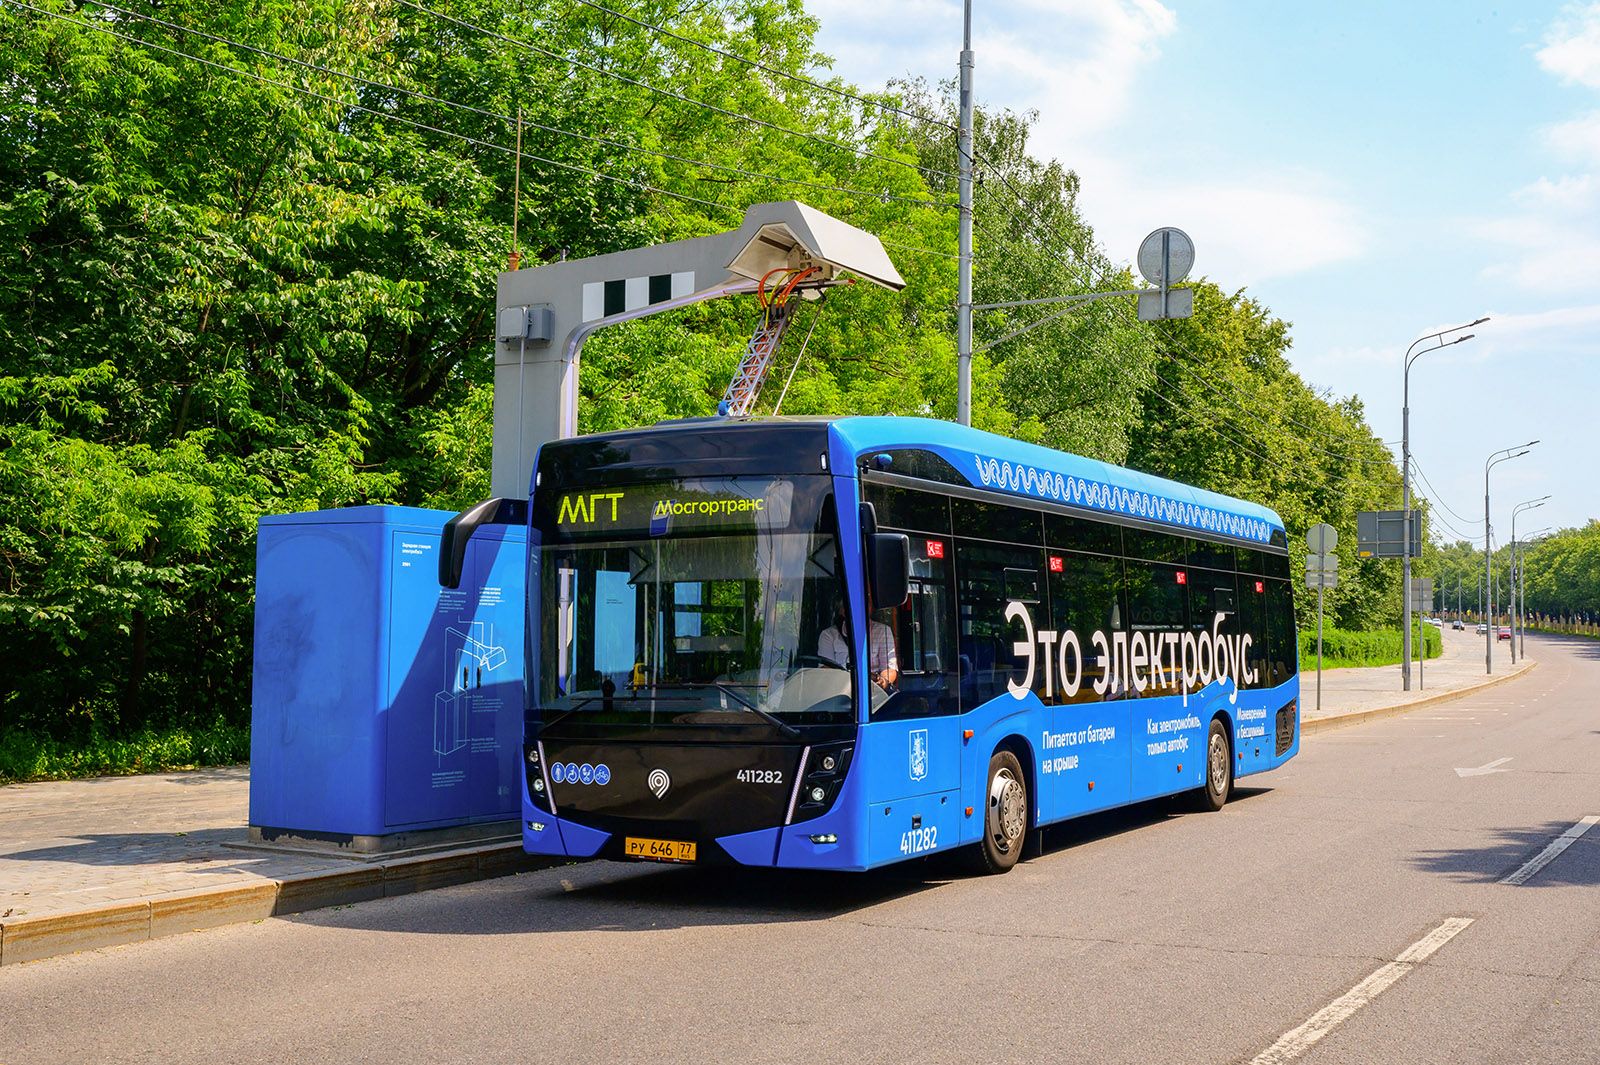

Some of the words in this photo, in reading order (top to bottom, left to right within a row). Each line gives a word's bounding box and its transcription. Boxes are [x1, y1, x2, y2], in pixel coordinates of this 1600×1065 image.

[557, 492, 624, 525] МГТ
[655, 497, 764, 517] Мосгортранс
[1004, 601, 1082, 700] Это
[1091, 612, 1259, 707] электробус.
[1147, 718, 1158, 735] Как
[1159, 713, 1202, 734] электромобиль,
[1236, 706, 1267, 723] Маневренный
[1042, 730, 1077, 750] Питается
[1077, 730, 1087, 745] от
[1087, 724, 1116, 745] батареи
[1240, 723, 1265, 740] бесшумный
[1146, 741, 1168, 756] только
[1167, 734, 1189, 753] автобус
[1042, 759, 1052, 774] на
[1053, 754, 1079, 776] крыше
[736, 769, 783, 785] 411282
[650, 841, 673, 856] 646
[680, 843, 692, 854] 77
[900, 825, 938, 855] 411282
